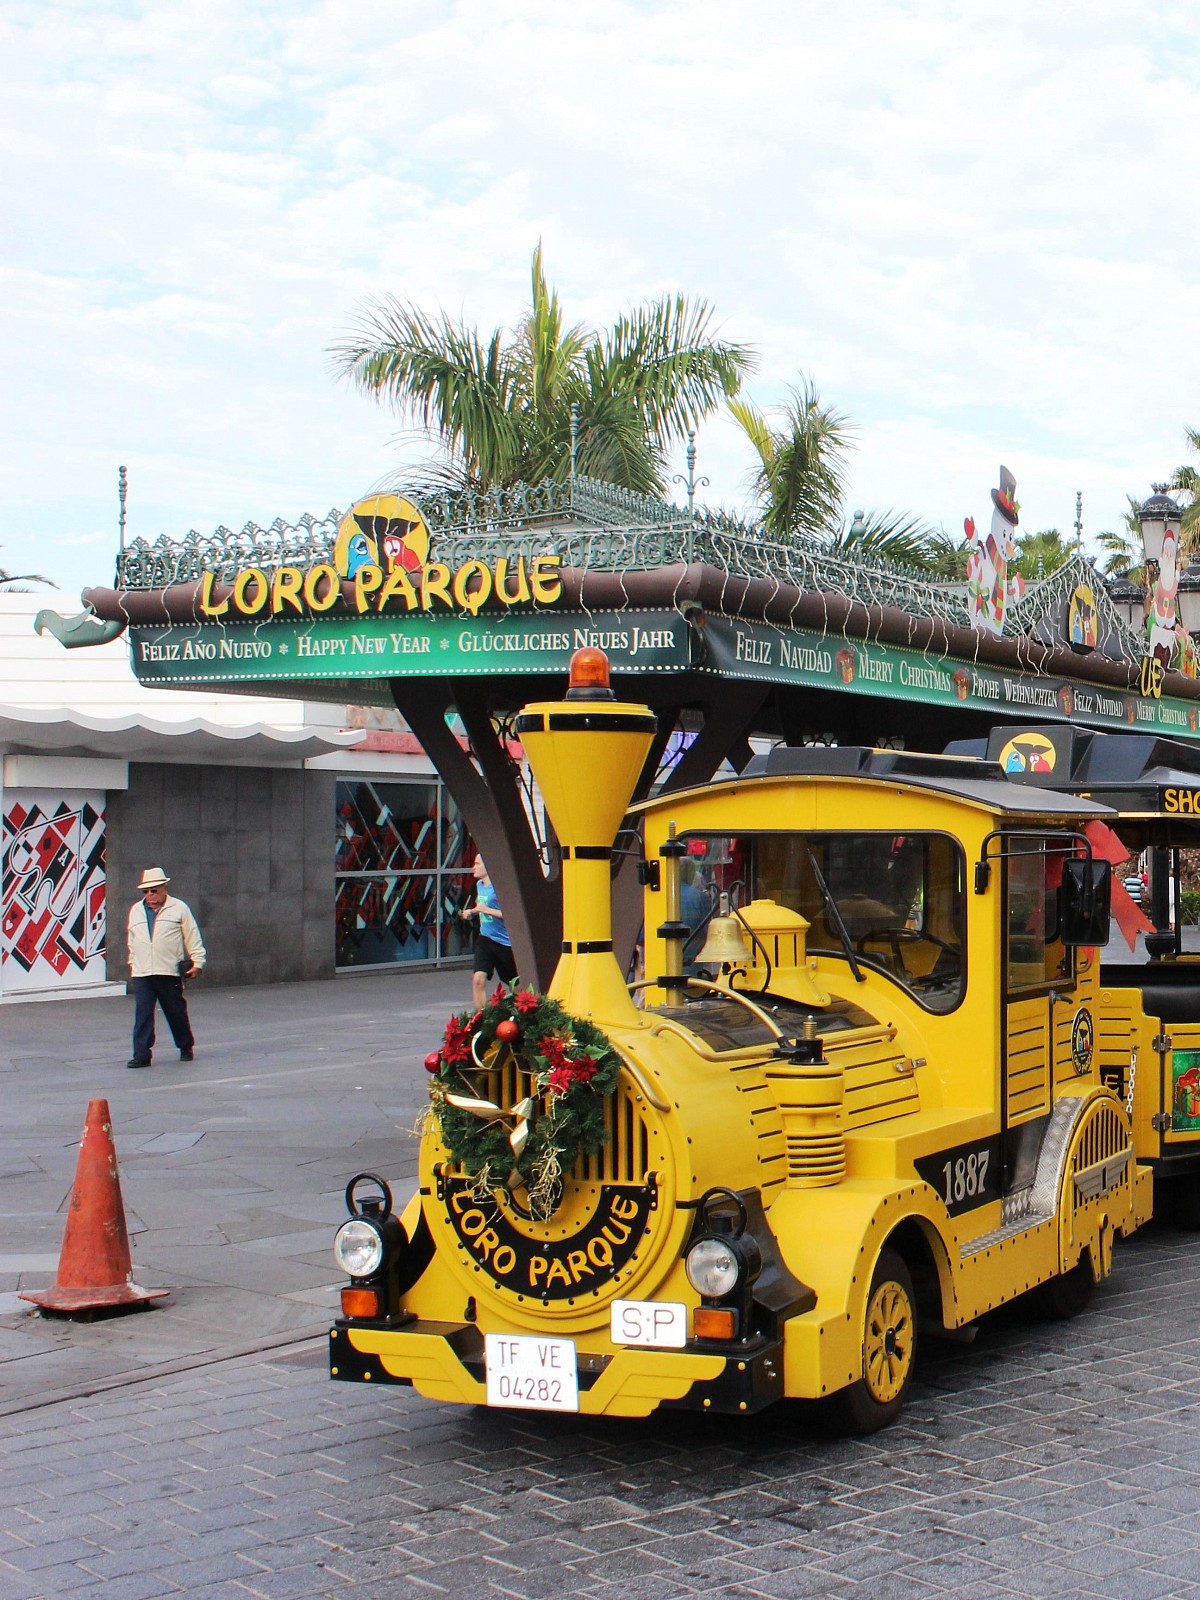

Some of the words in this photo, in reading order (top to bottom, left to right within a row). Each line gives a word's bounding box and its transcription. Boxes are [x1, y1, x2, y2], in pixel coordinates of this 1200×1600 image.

[201, 564, 340, 616] LORO
[355, 555, 563, 617] PARQUE
[140, 641, 181, 662] FELIZ
[182, 639, 215, 660] AÑO
[219, 639, 272, 660] NUEVO
[297, 636, 348, 657] HAPPY
[351, 634, 387, 655] NEW
[389, 633, 431, 654] YEAR
[458, 631, 570, 653] GLÜCKLICHES
[573, 628, 629, 651] NEUES
[629, 627, 675, 656] JAHR
[736, 631, 772, 665] FELIZ
[780, 639, 832, 674] NAVIDAD
[858, 653, 894, 683] MERRY
[900, 660, 951, 692] CHRISTMAS
[972, 673, 1000, 700] FROHE
[1003, 678, 1058, 708] WEIHNACHTEN
[1073, 689, 1093, 714] FELIZ
[1096, 693, 1124, 718] NAVIDAD
[1136, 701, 1155, 722] MERRY
[1158, 702, 1187, 727] CHRISTMAS
[58, 848, 70, 867] A
[51, 948, 63, 967] K
[942, 1150, 990, 1206] 1887
[451, 1189, 517, 1274] LORO
[529, 1194, 639, 1289] PARQUE
[497, 1341, 520, 1368] TF
[537, 1343, 562, 1369] VE
[499, 1375, 562, 1403] 04282
